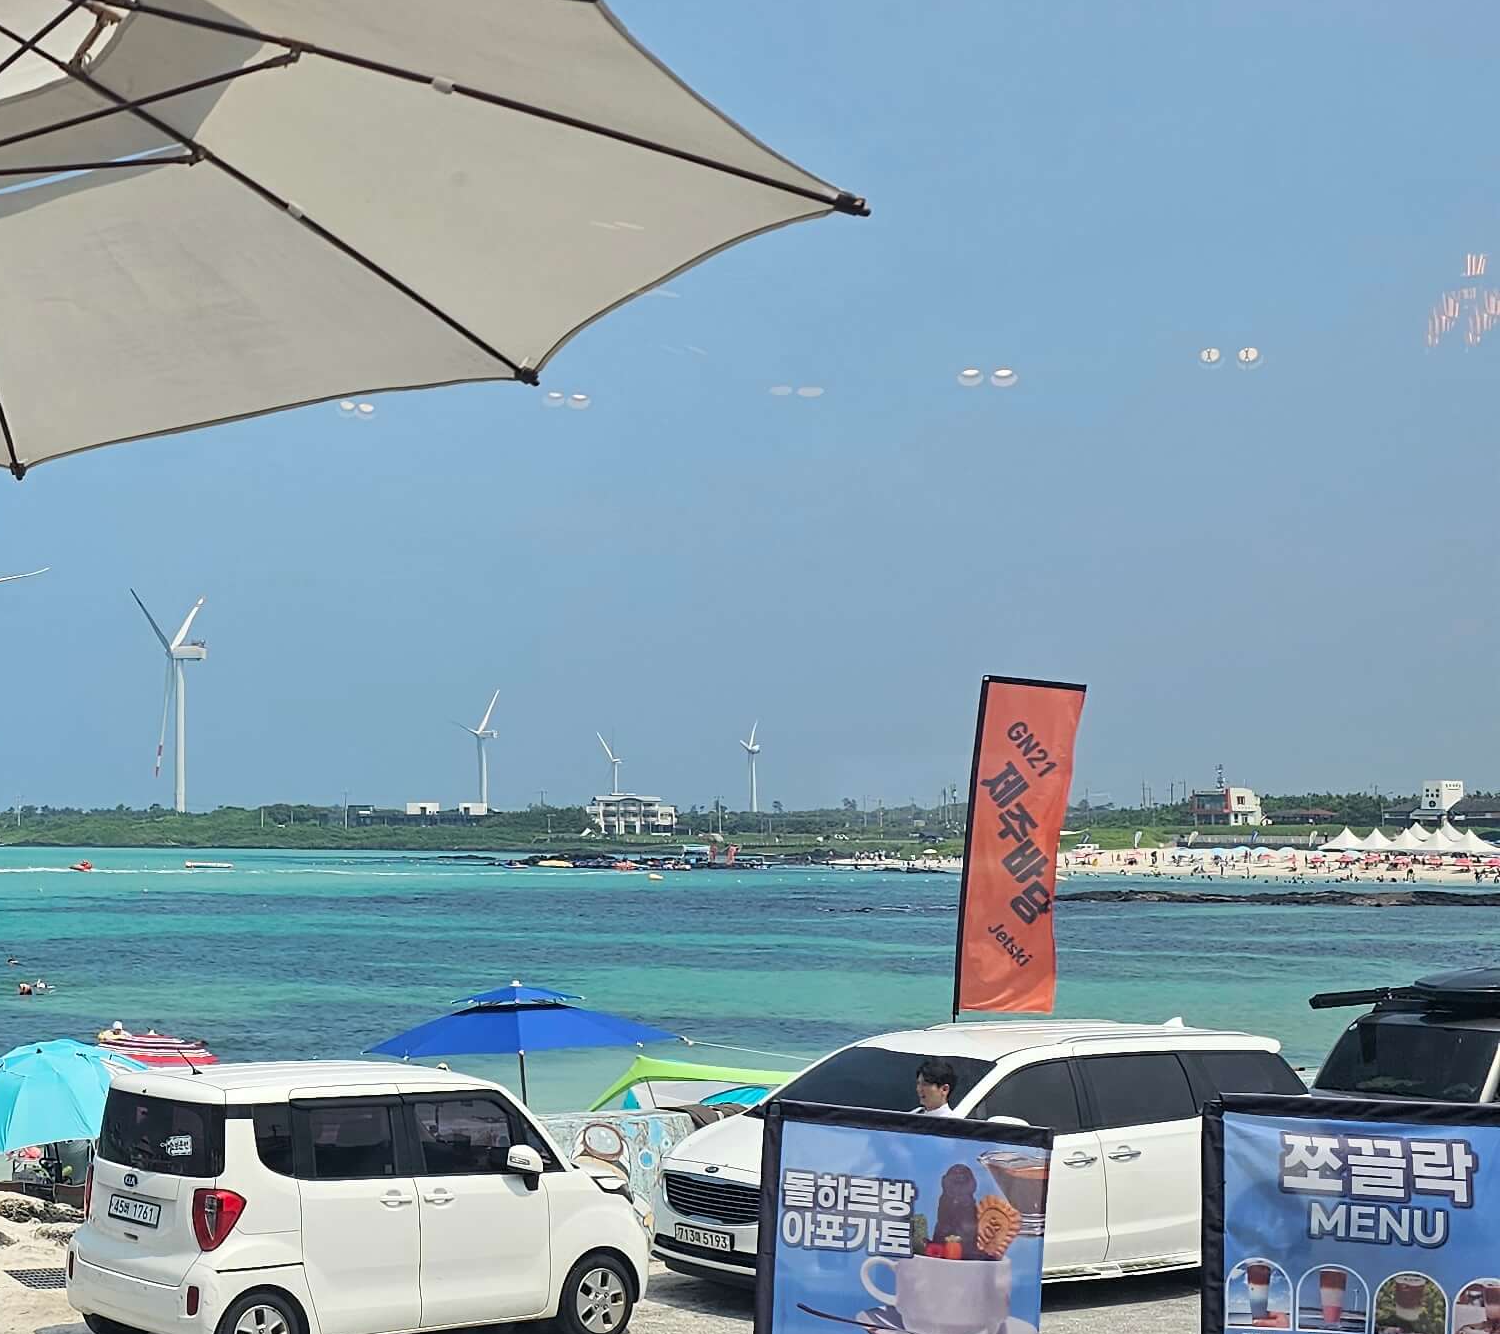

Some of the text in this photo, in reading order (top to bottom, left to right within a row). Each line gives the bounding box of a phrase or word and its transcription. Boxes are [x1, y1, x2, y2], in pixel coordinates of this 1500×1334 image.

[1007, 721, 1058, 777] GN21
[980, 761, 1053, 925] 제주바당
[987, 923, 1035, 968] Jetski
[1283, 1134, 1472, 1203] 쪼끌락
[133, 1203, 154, 1222] 1761
[783, 1170, 916, 1216] 돌하르방
[702, 1233, 727, 1249] 5193
[781, 1211, 912, 1255] 아포가토
[1310, 1202, 1445, 1244] MENU
